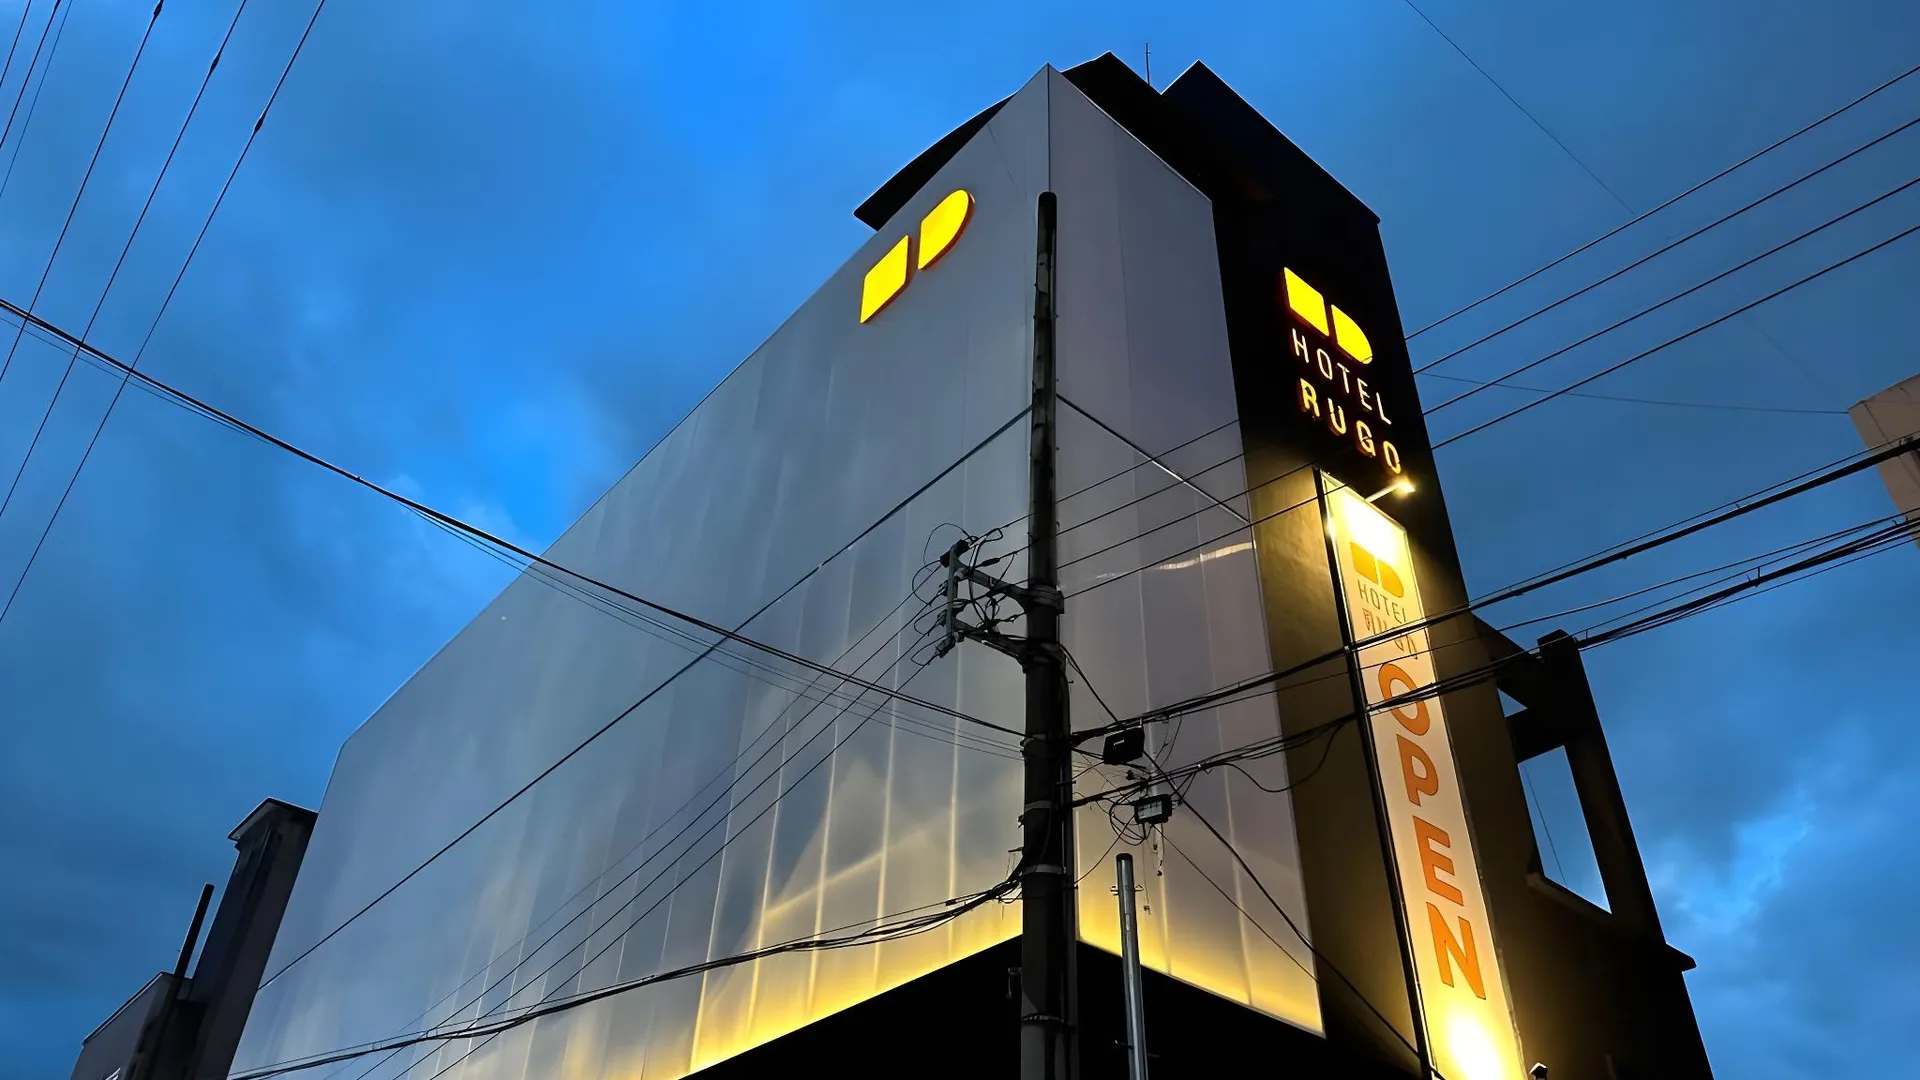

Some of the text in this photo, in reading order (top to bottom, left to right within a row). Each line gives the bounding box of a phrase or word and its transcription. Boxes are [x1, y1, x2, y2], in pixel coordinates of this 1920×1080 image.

[1292, 328, 1391, 425] HOTEL
[1299, 378, 1401, 474] RUGO
[1378, 663, 1486, 1000] OPEN
